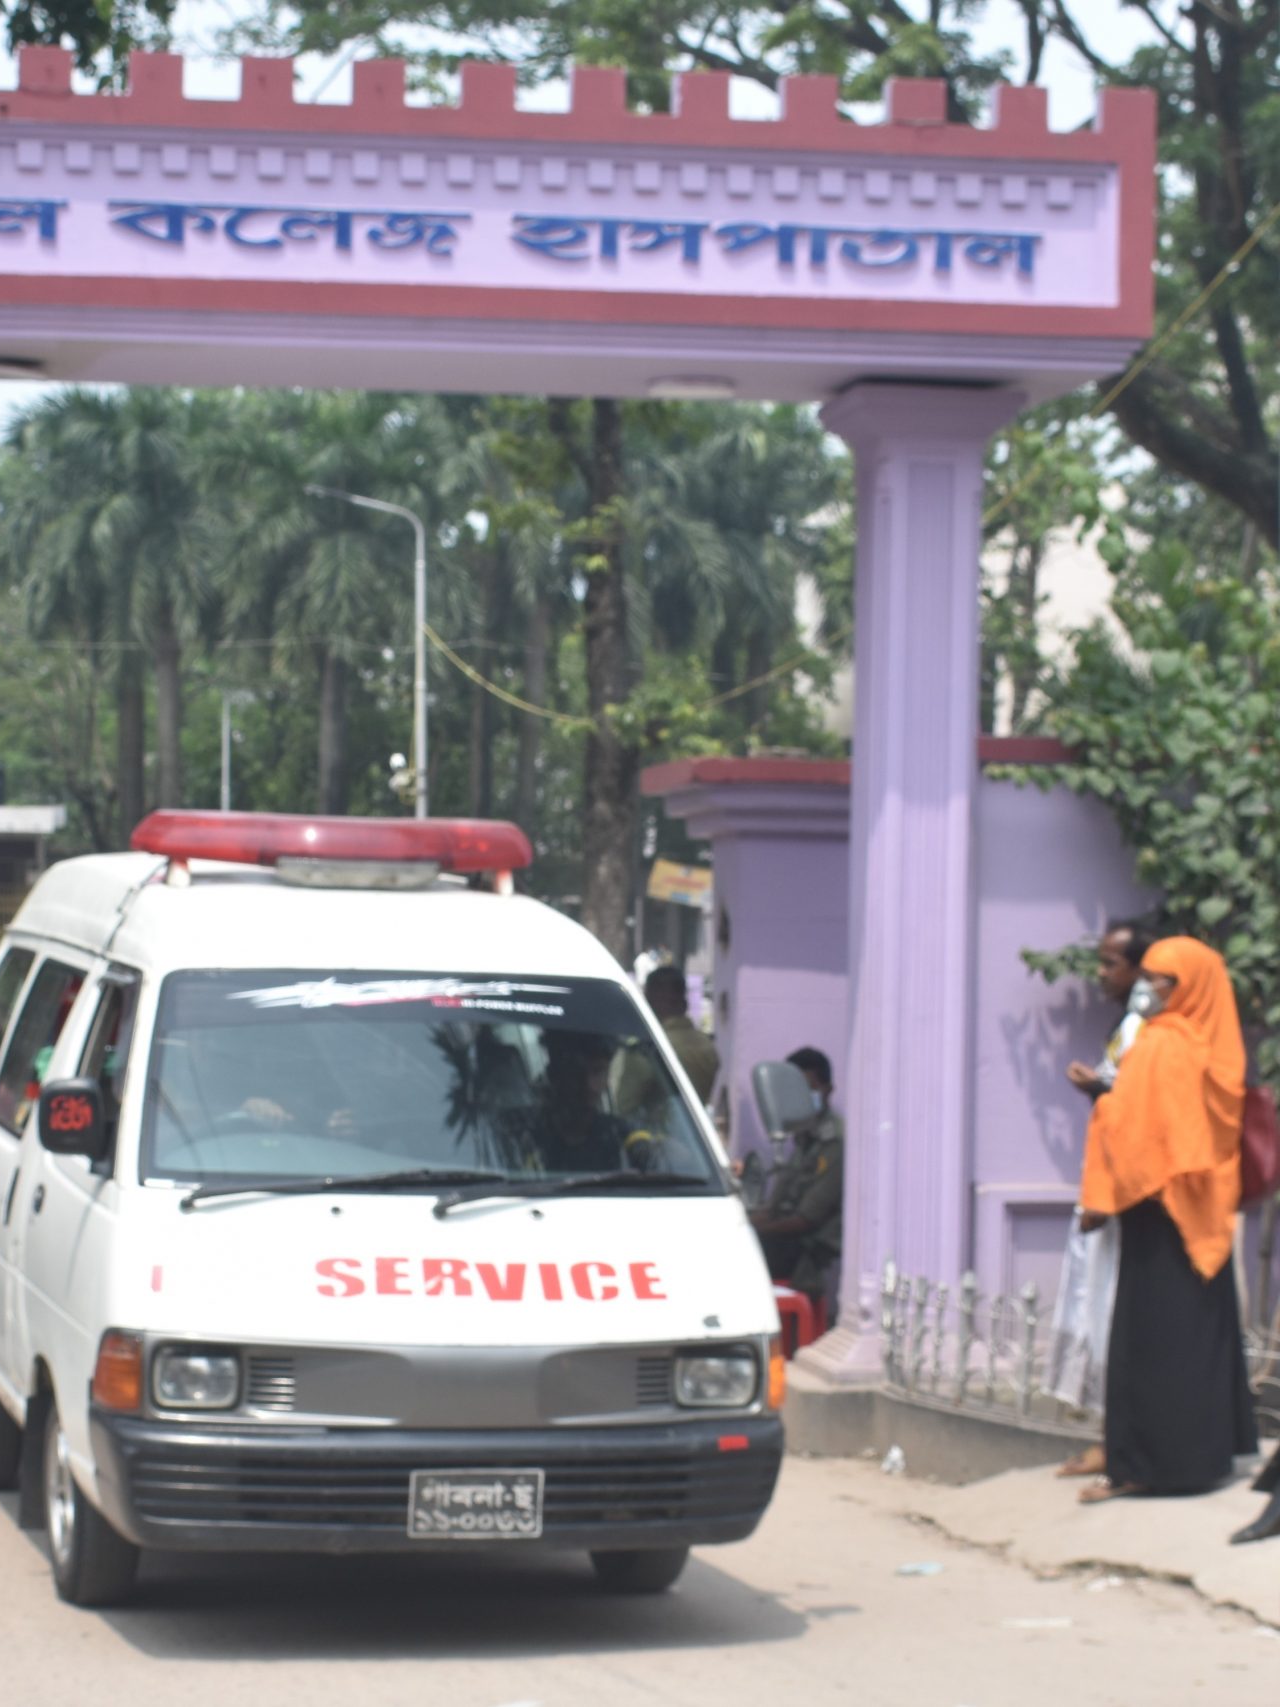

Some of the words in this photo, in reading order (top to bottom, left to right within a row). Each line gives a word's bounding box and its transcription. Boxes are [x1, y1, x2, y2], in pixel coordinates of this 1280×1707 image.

[108, 200, 472, 259] কলেজ
[511, 213, 1043, 276] হাসপাতাল
[315, 1256, 667, 1302] SERVICE
